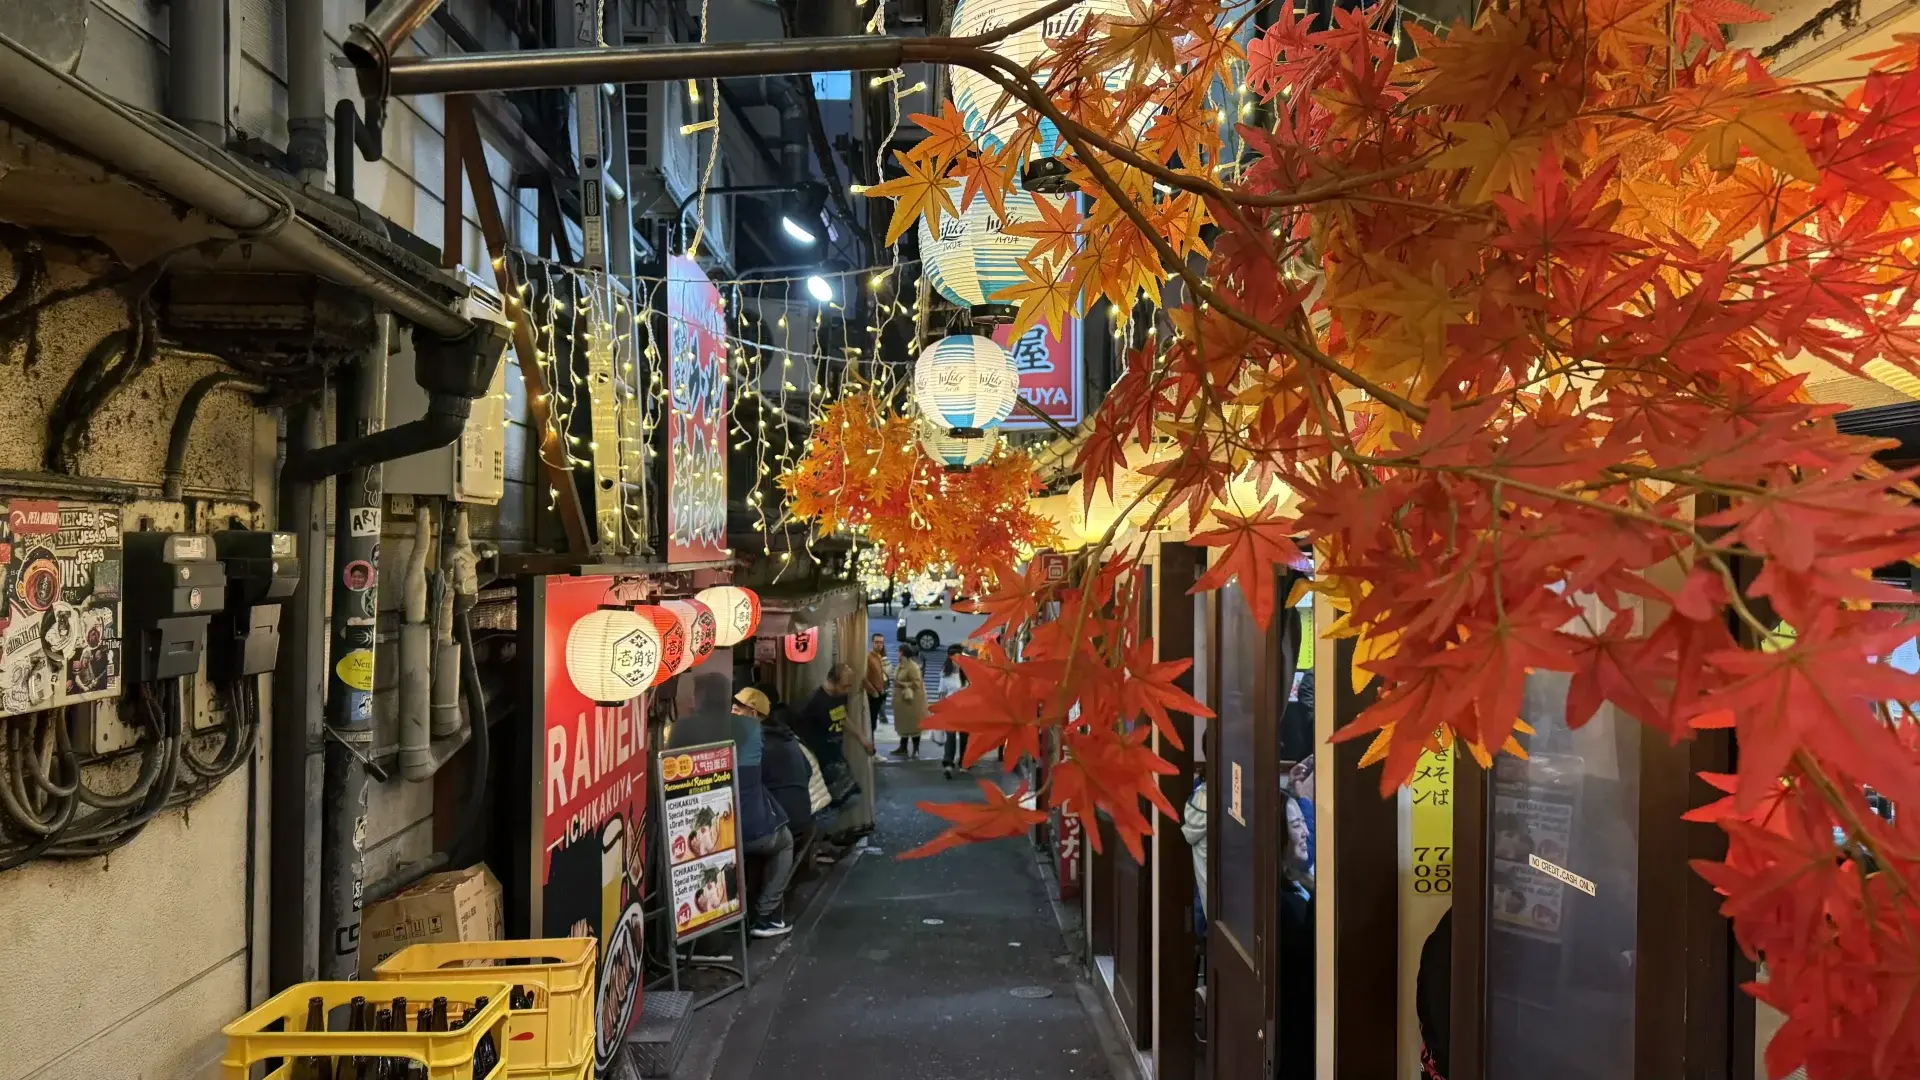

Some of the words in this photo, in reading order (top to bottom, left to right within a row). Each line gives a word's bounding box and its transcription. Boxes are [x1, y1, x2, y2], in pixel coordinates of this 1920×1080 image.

[994, 236, 1020, 245] ハイリキ
[75, 549, 105, 565] JESS3
[617, 649, 654, 667] 壱角家
[547, 694, 646, 817] RAMEN
[565, 772, 632, 849] ICHIKAKUYA
[1531, 856, 1540, 867] NO
[1579, 879, 1595, 893] ONLY
